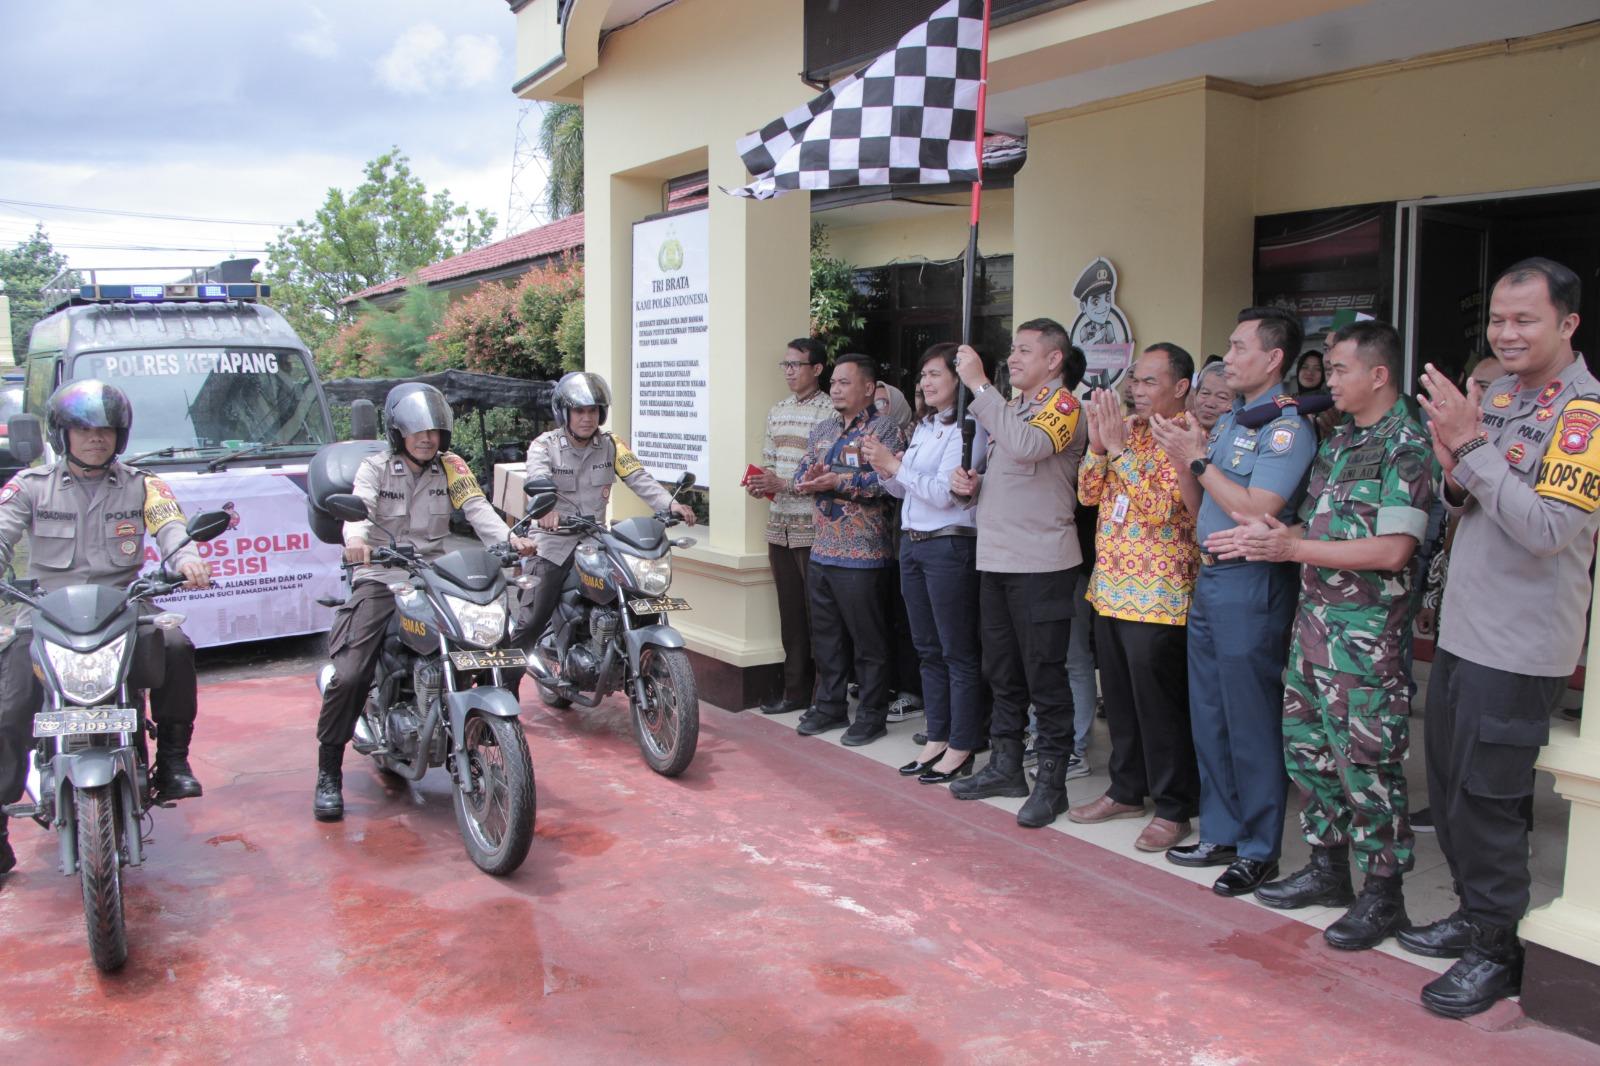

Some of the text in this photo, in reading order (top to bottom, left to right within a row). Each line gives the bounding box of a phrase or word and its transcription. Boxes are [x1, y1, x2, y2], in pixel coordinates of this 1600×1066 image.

[652, 276, 689, 293] TRI BRATA
[636, 293, 708, 311] KAMI POLISI INDONESIA
[1299, 294, 1375, 308] PRESISI
[105, 352, 279, 377] POLRES KETAPANG
[1037, 411, 1060, 427] OPS
[1517, 424, 1546, 443] POLRI
[1550, 462, 1583, 491] OPS
[105, 509, 142, 521] POLRI
[236, 533, 310, 554] POLRI
[210, 556, 268, 578] ESISI
[225, 579, 257, 591] ALIANSI
[258, 576, 276, 587] BEM
[278, 574, 295, 584] DAN
[297, 572, 313, 581] OKP
[189, 591, 215, 601] BULAN
[216, 590, 234, 598] SUCI
[235, 585, 278, 596] RAMADHAN
